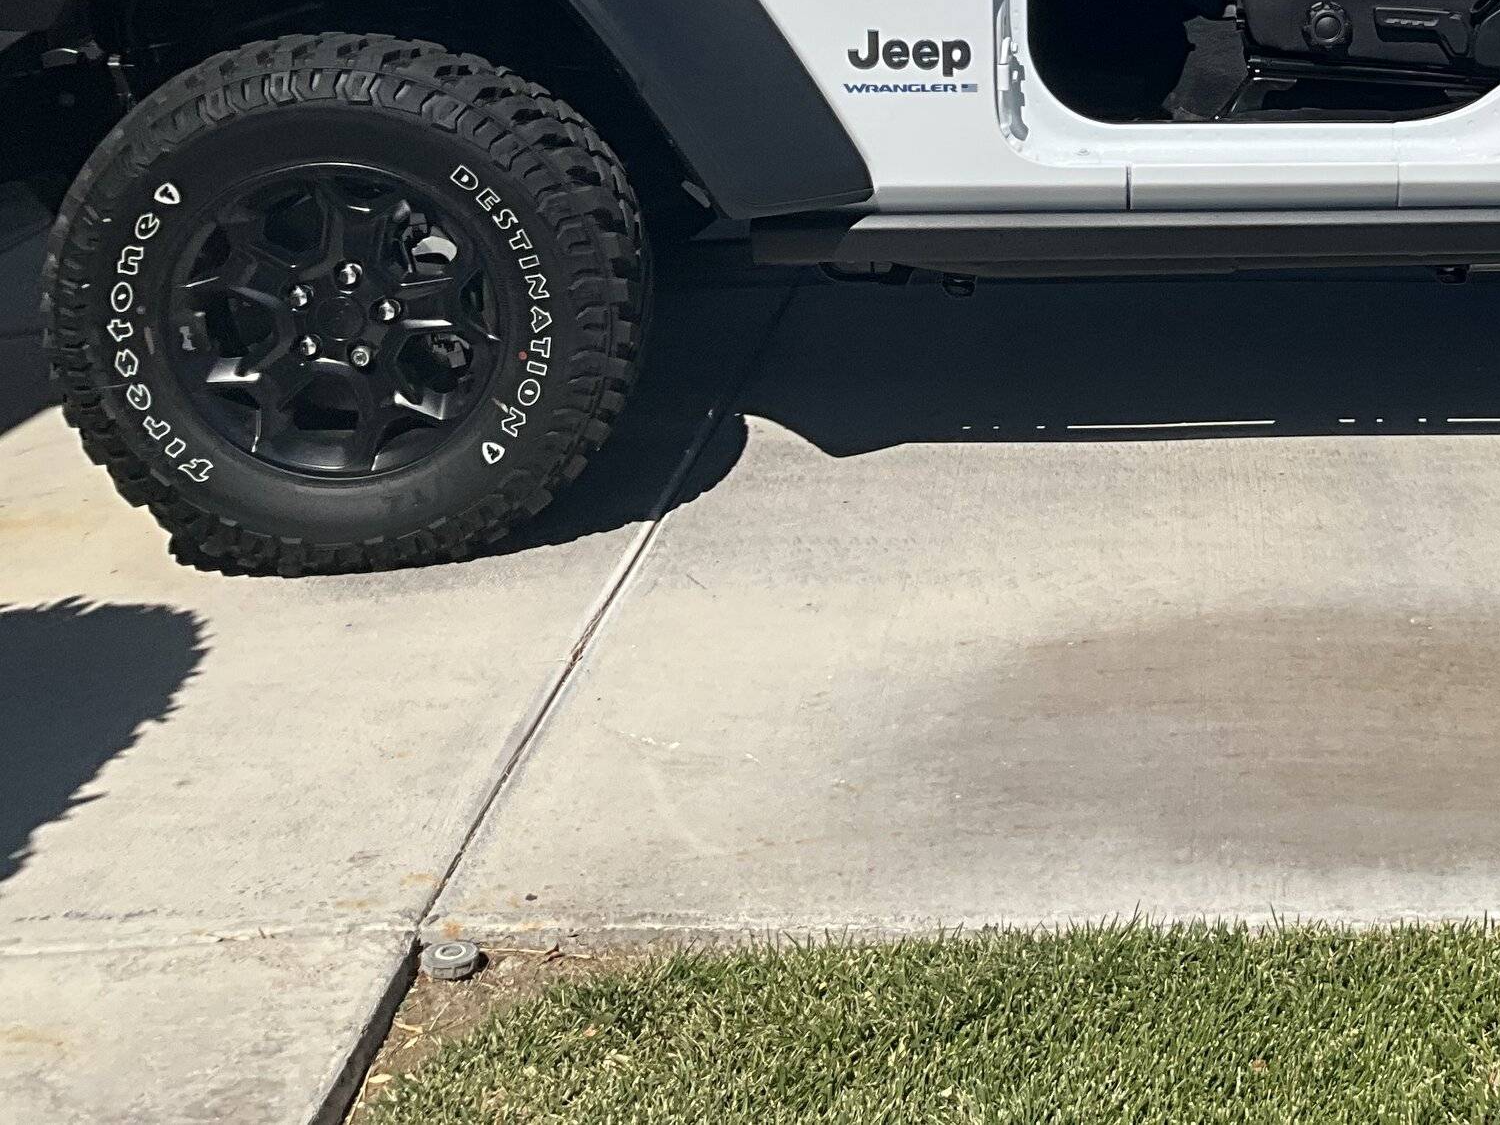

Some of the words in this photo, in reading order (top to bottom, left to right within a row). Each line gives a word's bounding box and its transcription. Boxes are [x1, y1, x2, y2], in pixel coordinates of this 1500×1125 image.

[847, 28, 972, 77] Jeep
[843, 83, 958, 93] WRANGLER
[450, 164, 552, 437] DESTINATION
